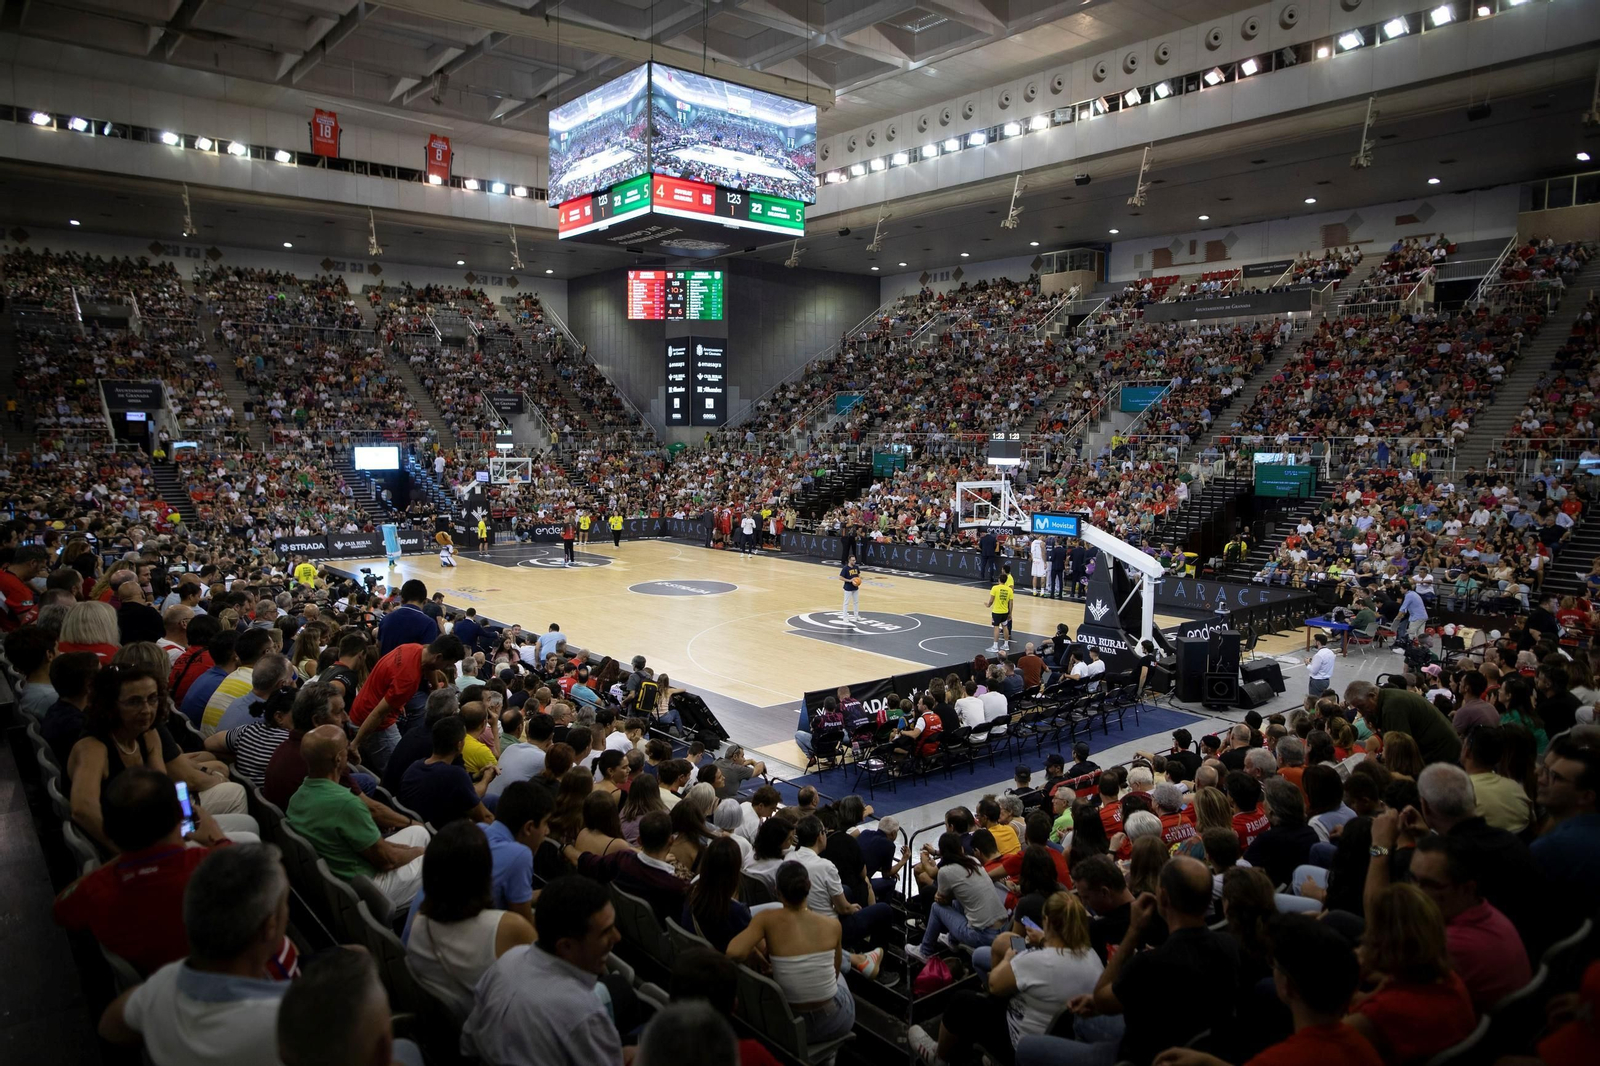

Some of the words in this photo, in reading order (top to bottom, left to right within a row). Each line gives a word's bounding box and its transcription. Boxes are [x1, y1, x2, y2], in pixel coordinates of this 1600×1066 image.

[320, 124, 331, 138] 18
[436, 149, 442, 160] 8
[643, 184, 648, 198] 5
[656, 185, 664, 198] 4
[702, 194, 712, 205] 15
[730, 205, 734, 215] 1
[751, 202, 762, 214] 22
[560, 212, 565, 224] 4
[795, 209, 802, 222] 5
[992, 432, 1004, 440] 1:23
[1009, 432, 1020, 440] 1:23
[987, 526, 1013, 535] endesa
[1051, 521, 1075, 530] Movistar
[289, 542, 326, 551] STRADA
[1077, 634, 1097, 645] CAJA
[1098, 637, 1128, 650] RURAL
